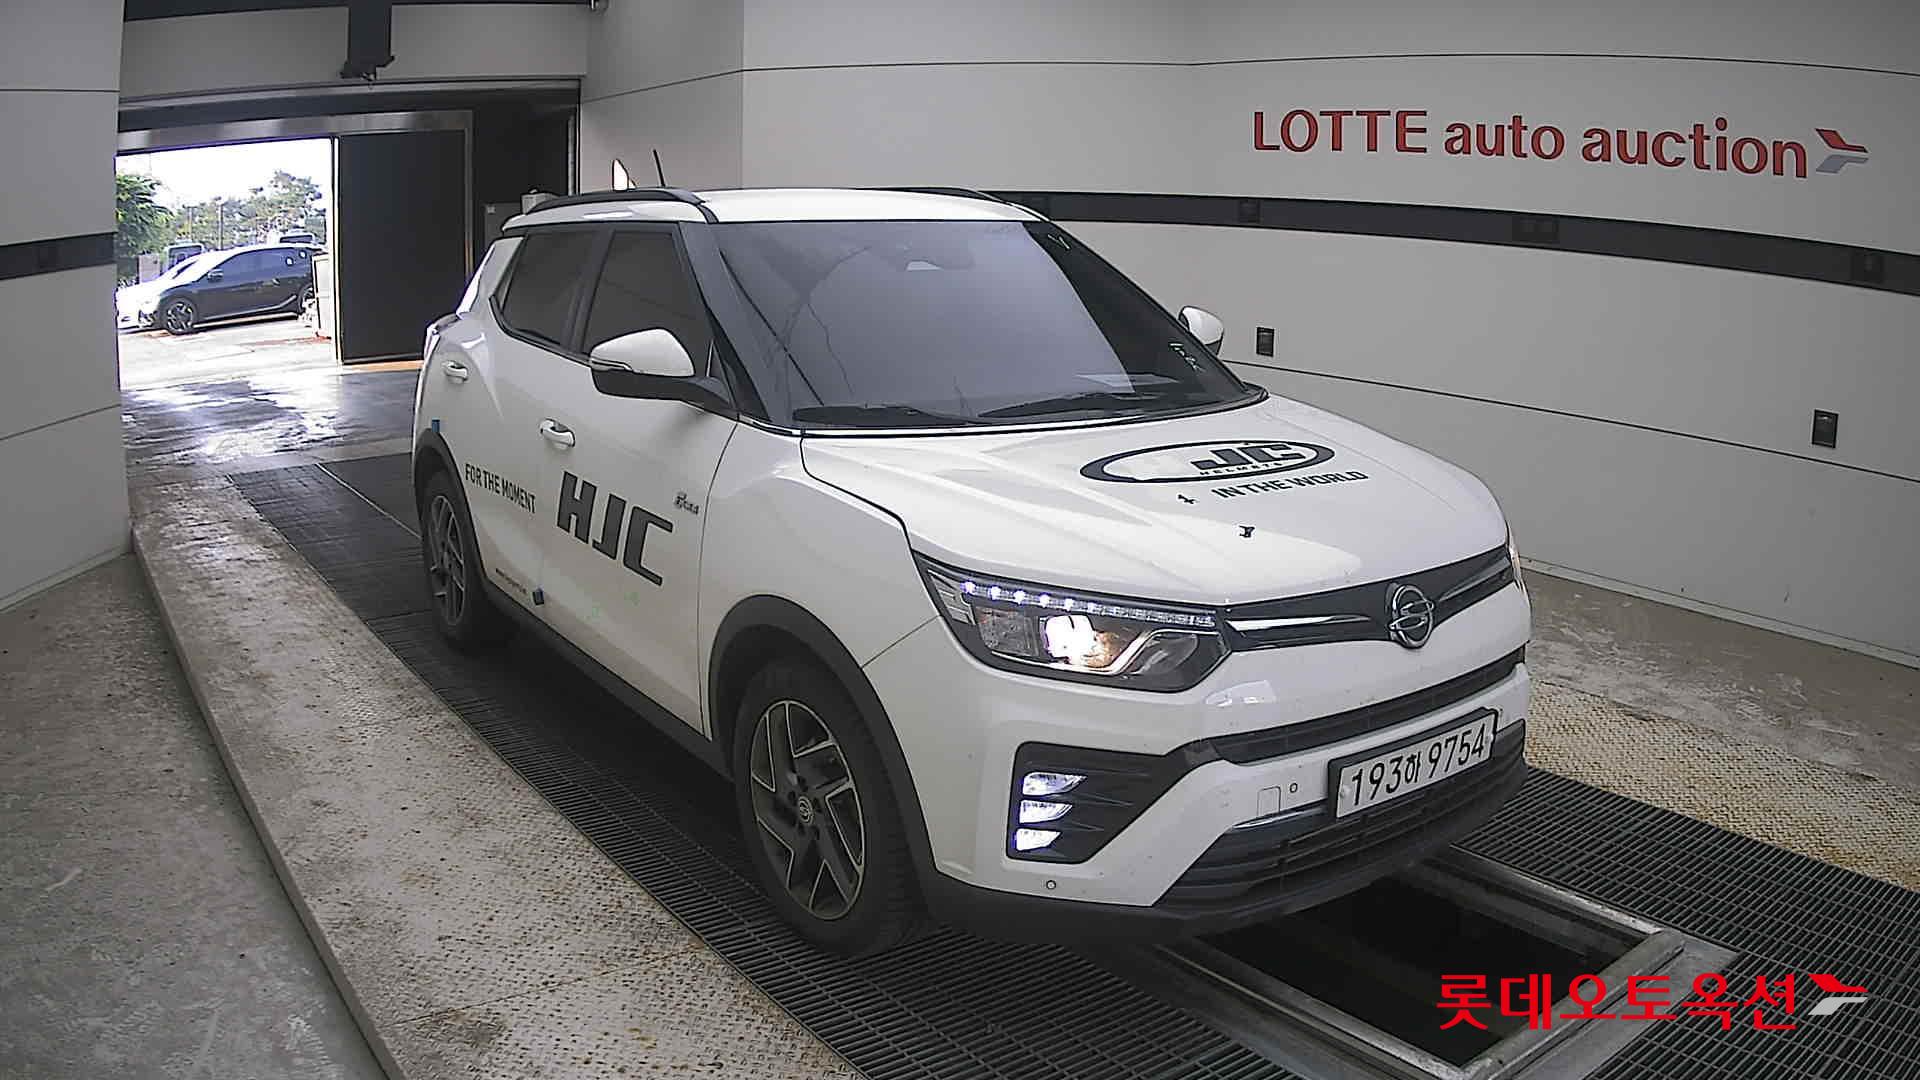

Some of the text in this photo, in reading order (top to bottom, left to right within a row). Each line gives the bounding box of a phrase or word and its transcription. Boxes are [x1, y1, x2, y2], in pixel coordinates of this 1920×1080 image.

[1253, 109, 1808, 179] LOTTE auto auction
[465, 463, 536, 513] FOR THE MOMENT
[1211, 486, 1246, 498] IN
[1238, 480, 1292, 494] THE
[1286, 471, 1369, 487] WORLD
[556, 470, 674, 587] HJC
[1351, 723, 1486, 806] 193하 9754
